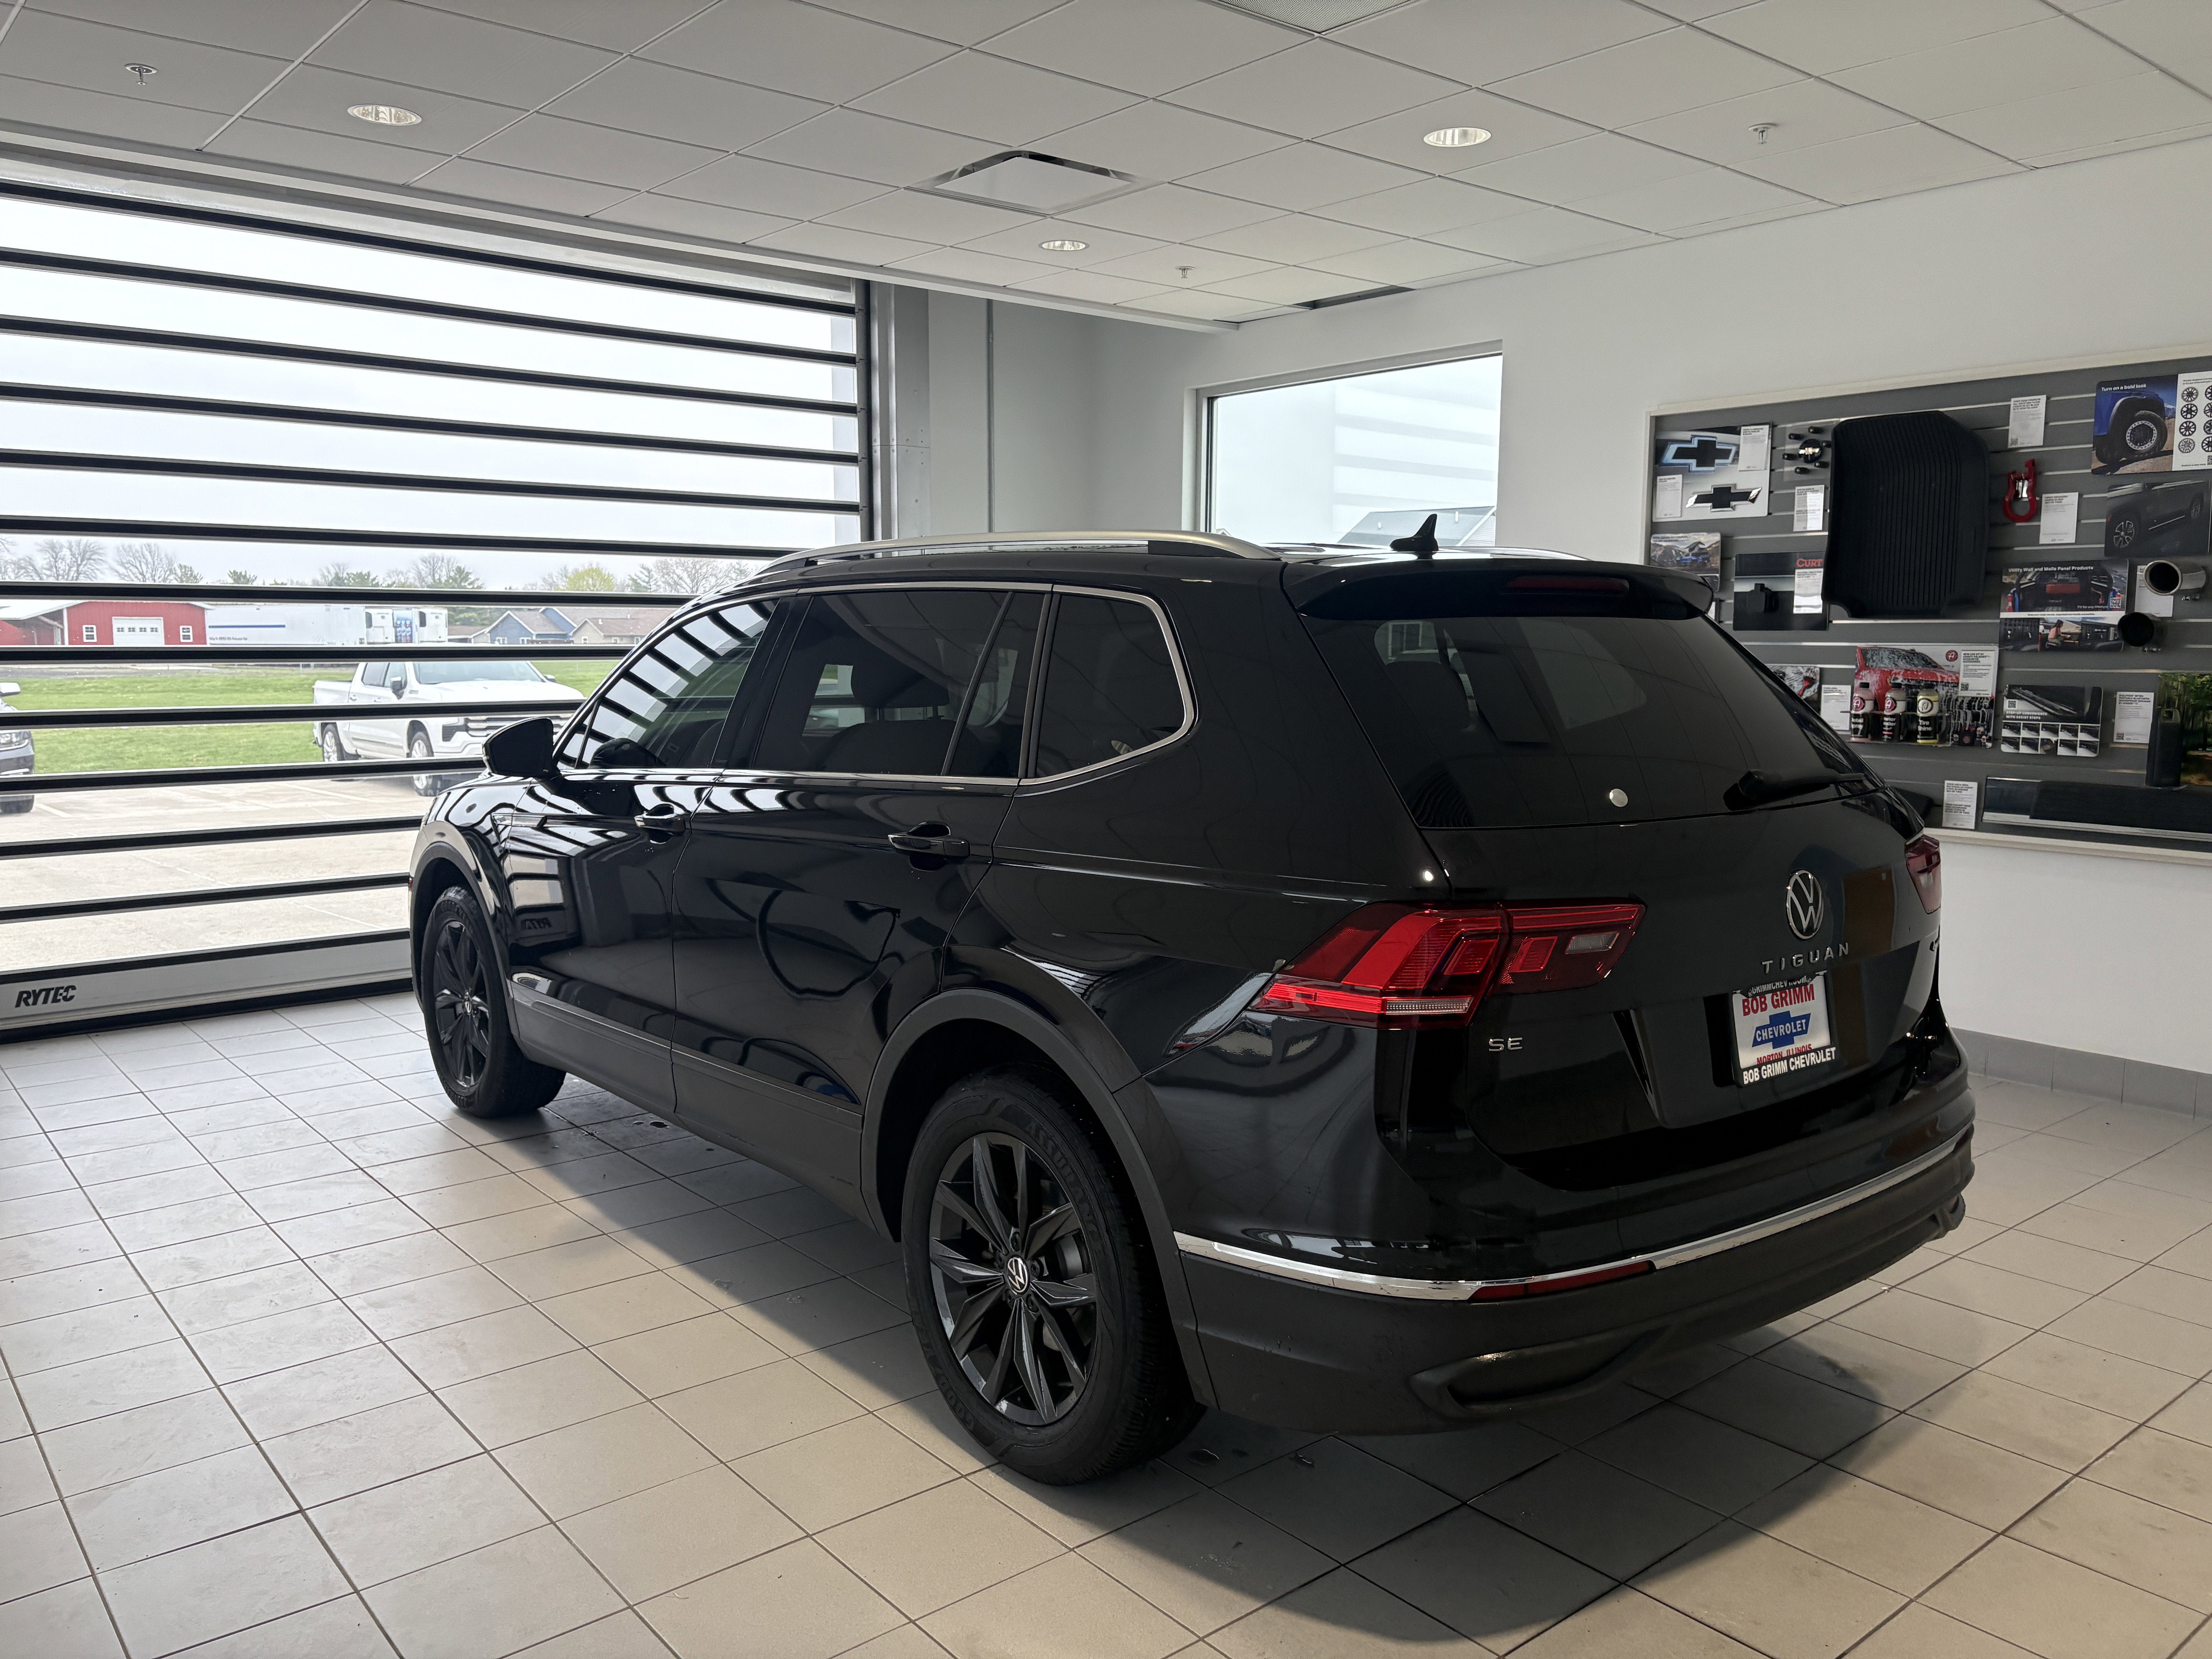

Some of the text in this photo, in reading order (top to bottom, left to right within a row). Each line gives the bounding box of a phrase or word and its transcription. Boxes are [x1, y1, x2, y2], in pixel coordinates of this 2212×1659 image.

[1797, 558, 1822, 568] CURT
[1762, 942, 1848, 974] TIGUAN
[15, 985, 77, 1008] RYTEC
[1742, 984, 1815, 1017] BOB GRIMM
[1755, 1019, 1806, 1042] CHEVROLET
[1489, 1037, 1523, 1051] SE
[1743, 1047, 1836, 1085] BOB GRIMM CHEVROLET
[1757, 1051, 1783, 1065] MORTON
